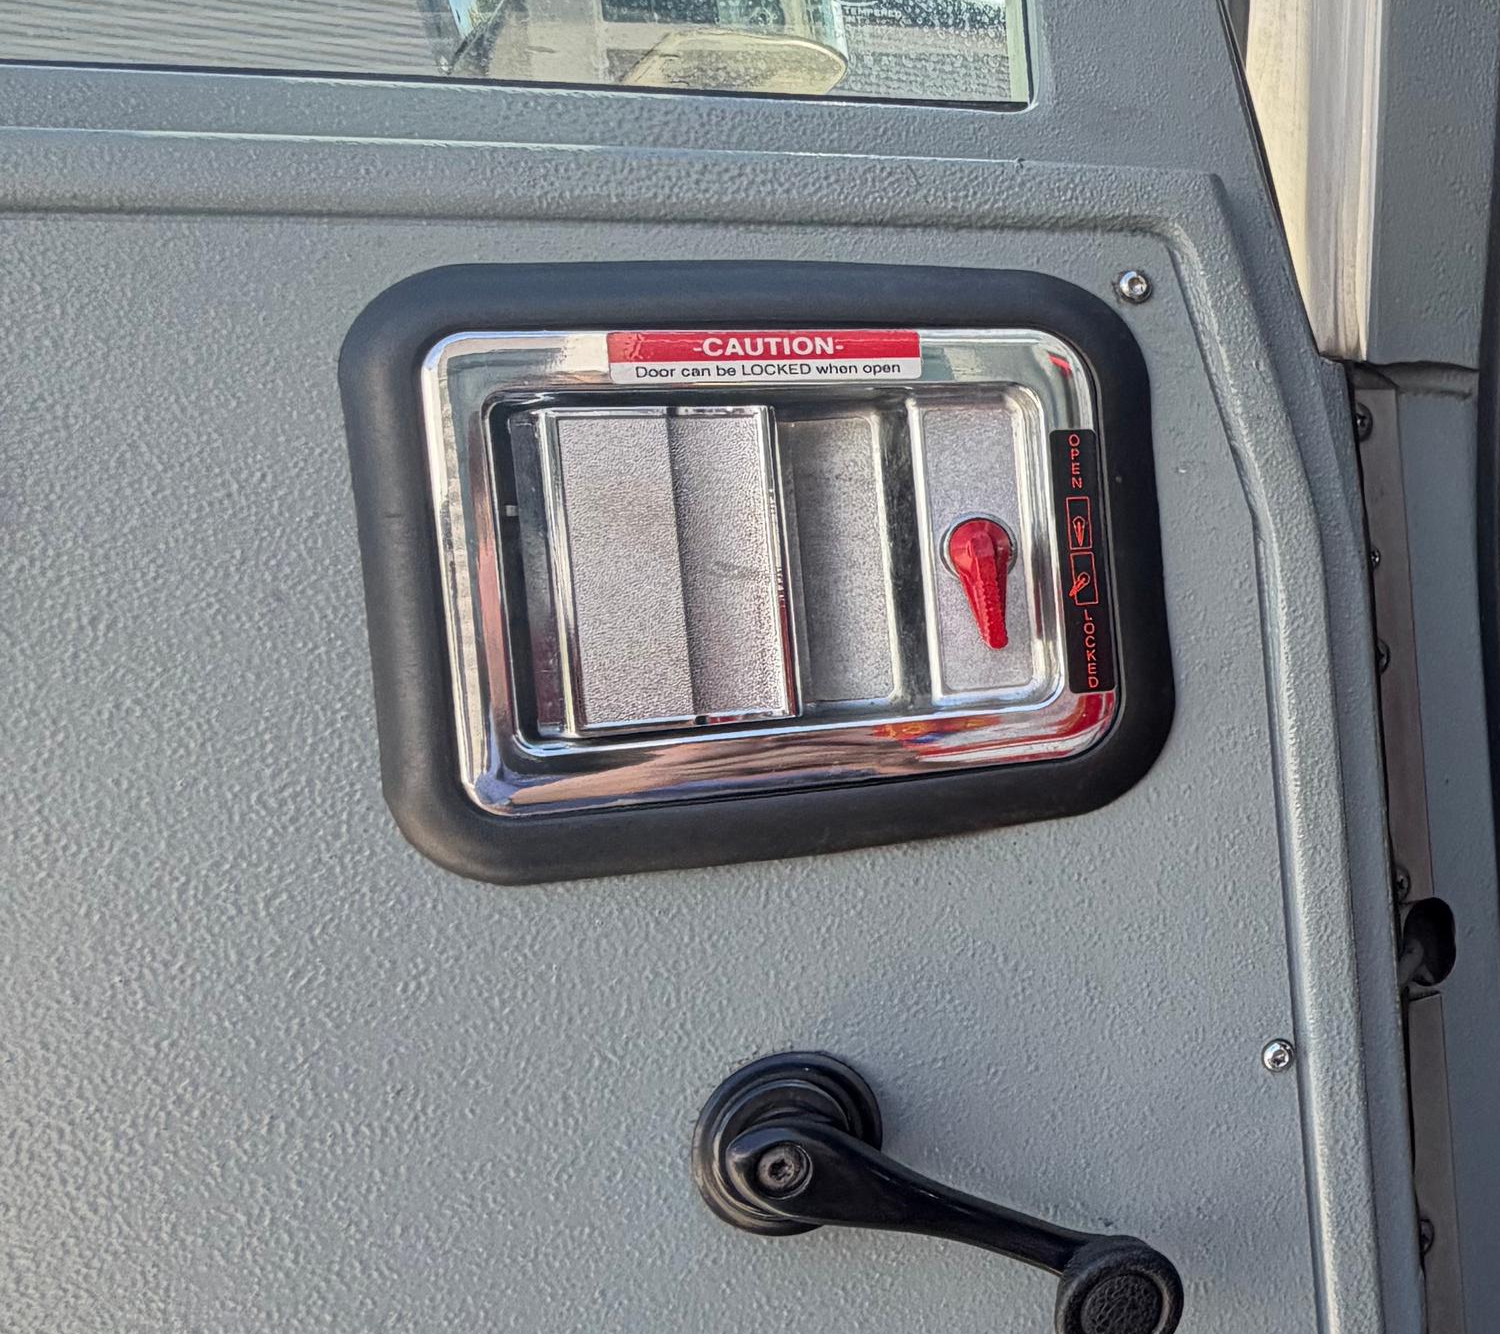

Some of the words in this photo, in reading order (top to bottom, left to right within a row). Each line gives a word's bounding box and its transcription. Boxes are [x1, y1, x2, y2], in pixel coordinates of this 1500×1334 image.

[635, 366, 675, 378] Door
[681, 368, 711, 377] can
[716, 365, 736, 377] be
[742, 364, 811, 377] LOCKED
[816, 362, 858, 375] when
[863, 364, 901, 376] open
[1068, 434, 1082, 489] OPEN
[1084, 609, 1099, 689] LOCKED
